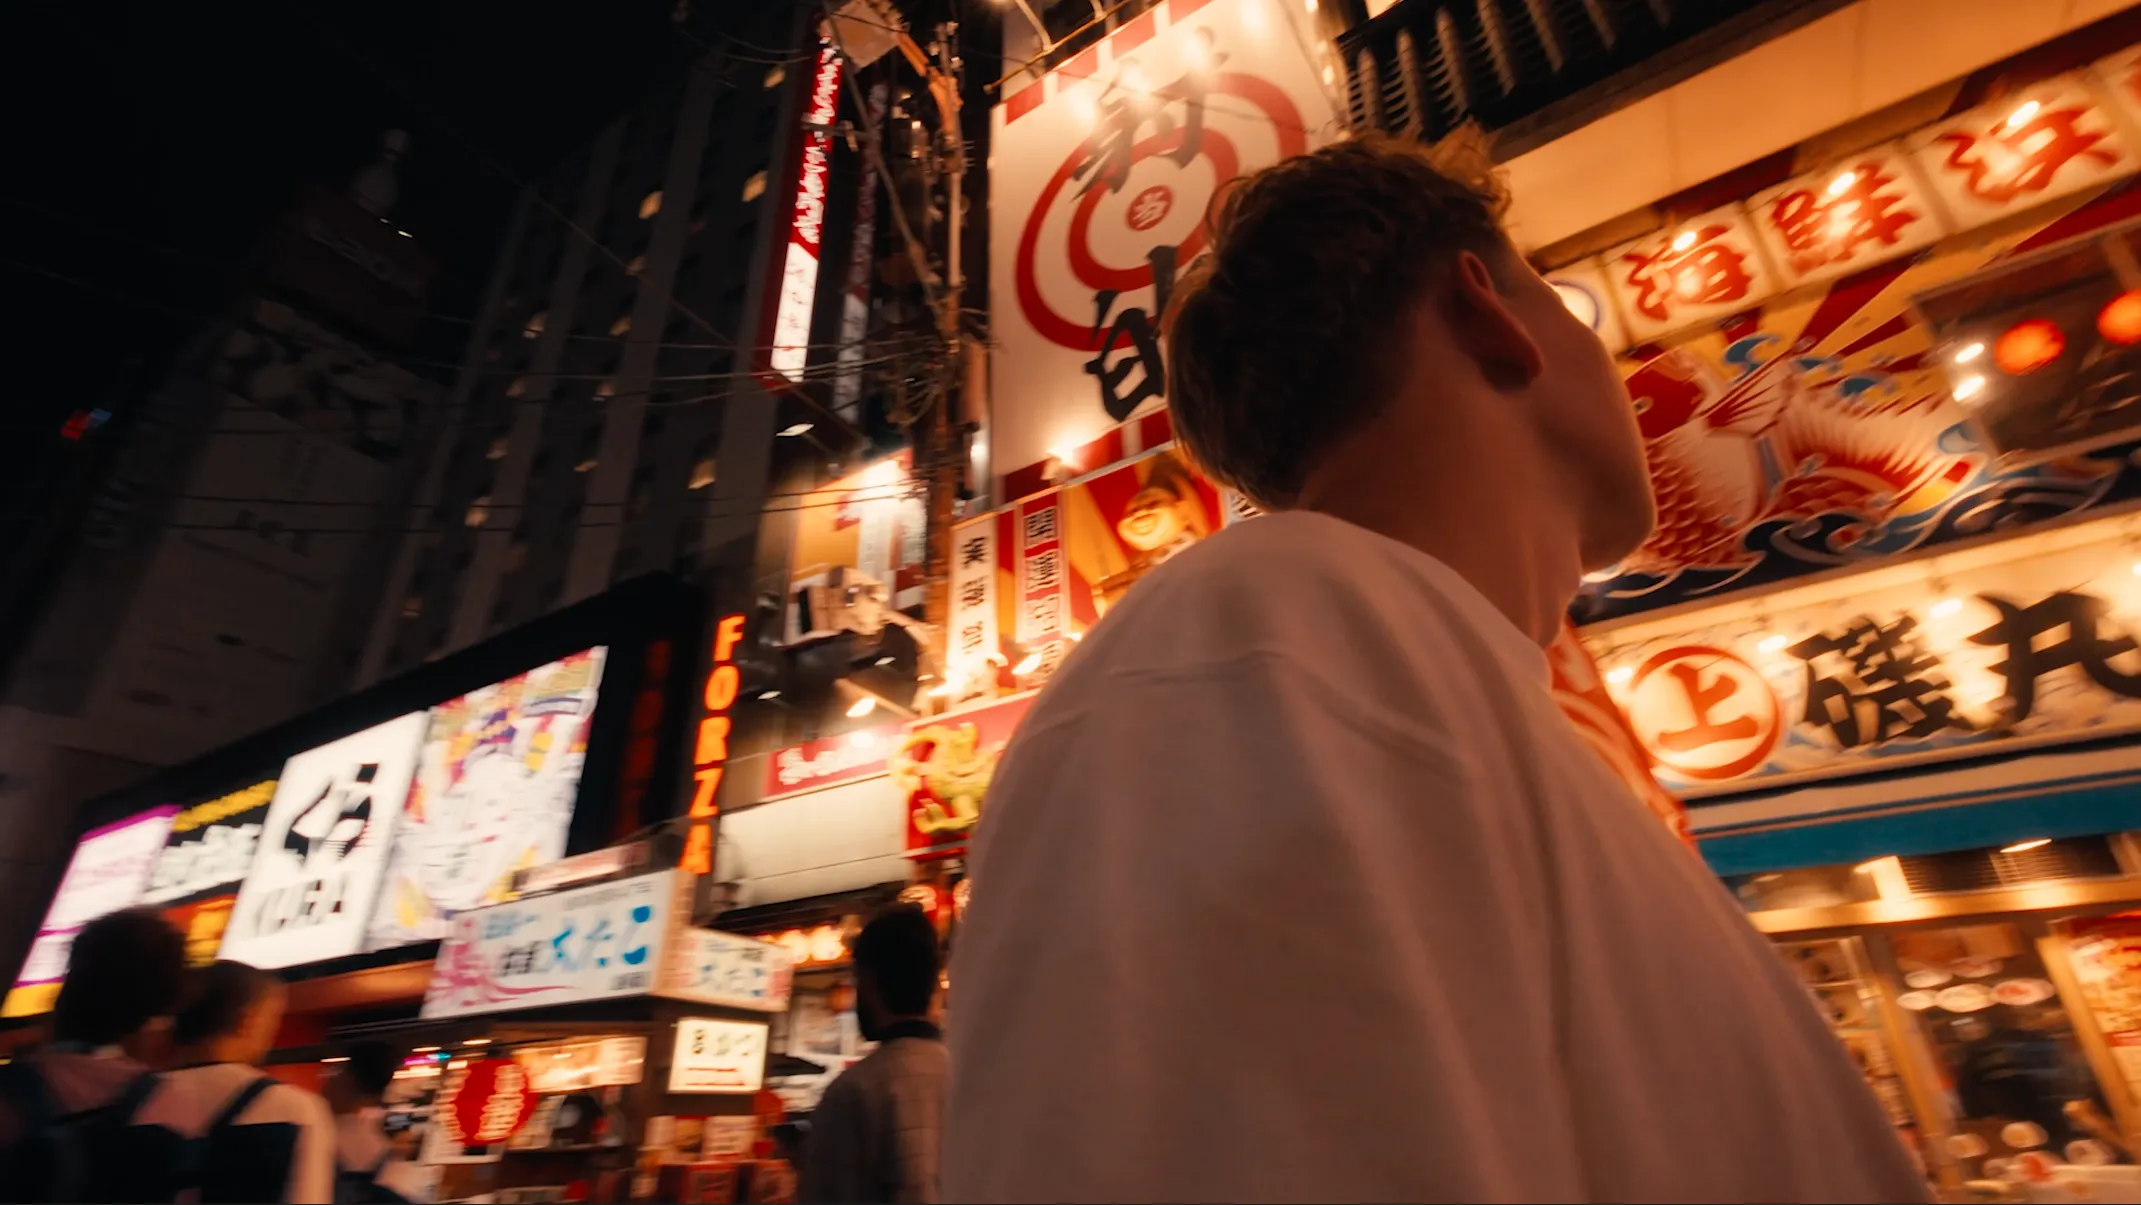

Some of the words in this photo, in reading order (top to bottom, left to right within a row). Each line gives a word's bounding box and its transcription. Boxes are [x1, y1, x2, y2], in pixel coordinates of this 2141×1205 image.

[1622, 52, 2141, 322] 海鮮浜
[679, 614, 746, 874] FORZA
[1657, 660, 1759, 751] 上
